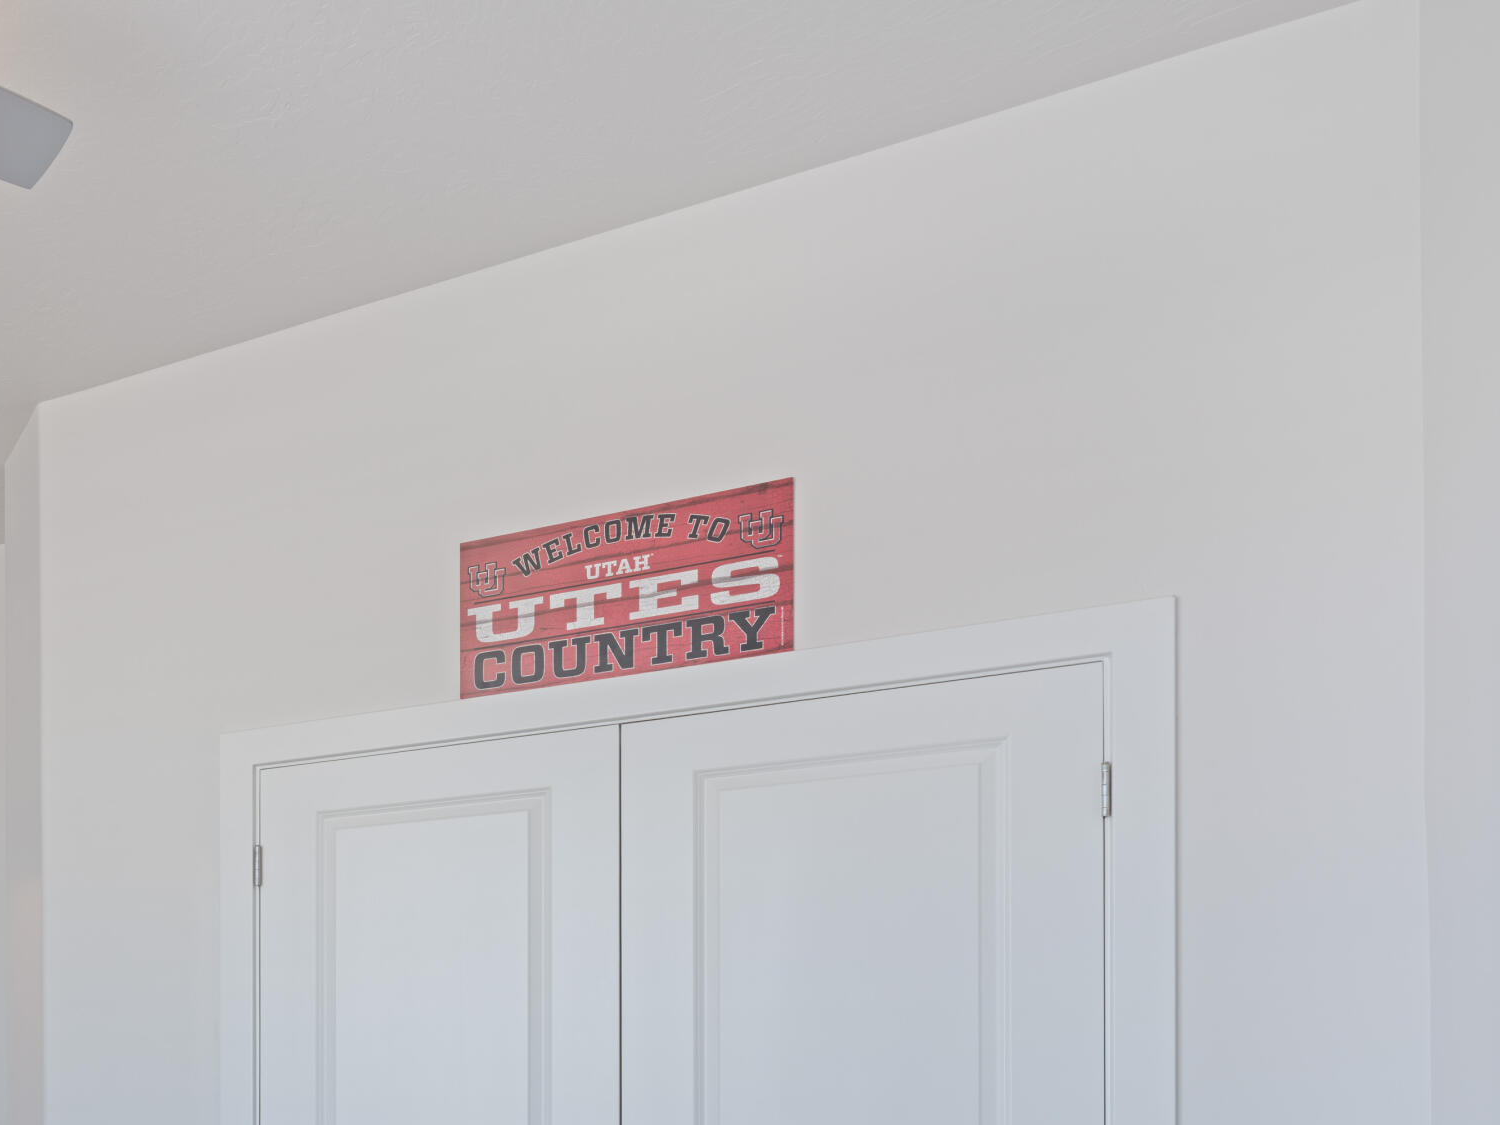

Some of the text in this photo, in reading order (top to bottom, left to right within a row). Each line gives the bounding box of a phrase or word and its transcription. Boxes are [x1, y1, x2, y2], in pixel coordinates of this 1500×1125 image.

[512, 513, 731, 577] WELCOME TO
[585, 554, 650, 580] UTAH
[467, 556, 781, 643] UTES
[472, 606, 776, 691] COUNTRY
